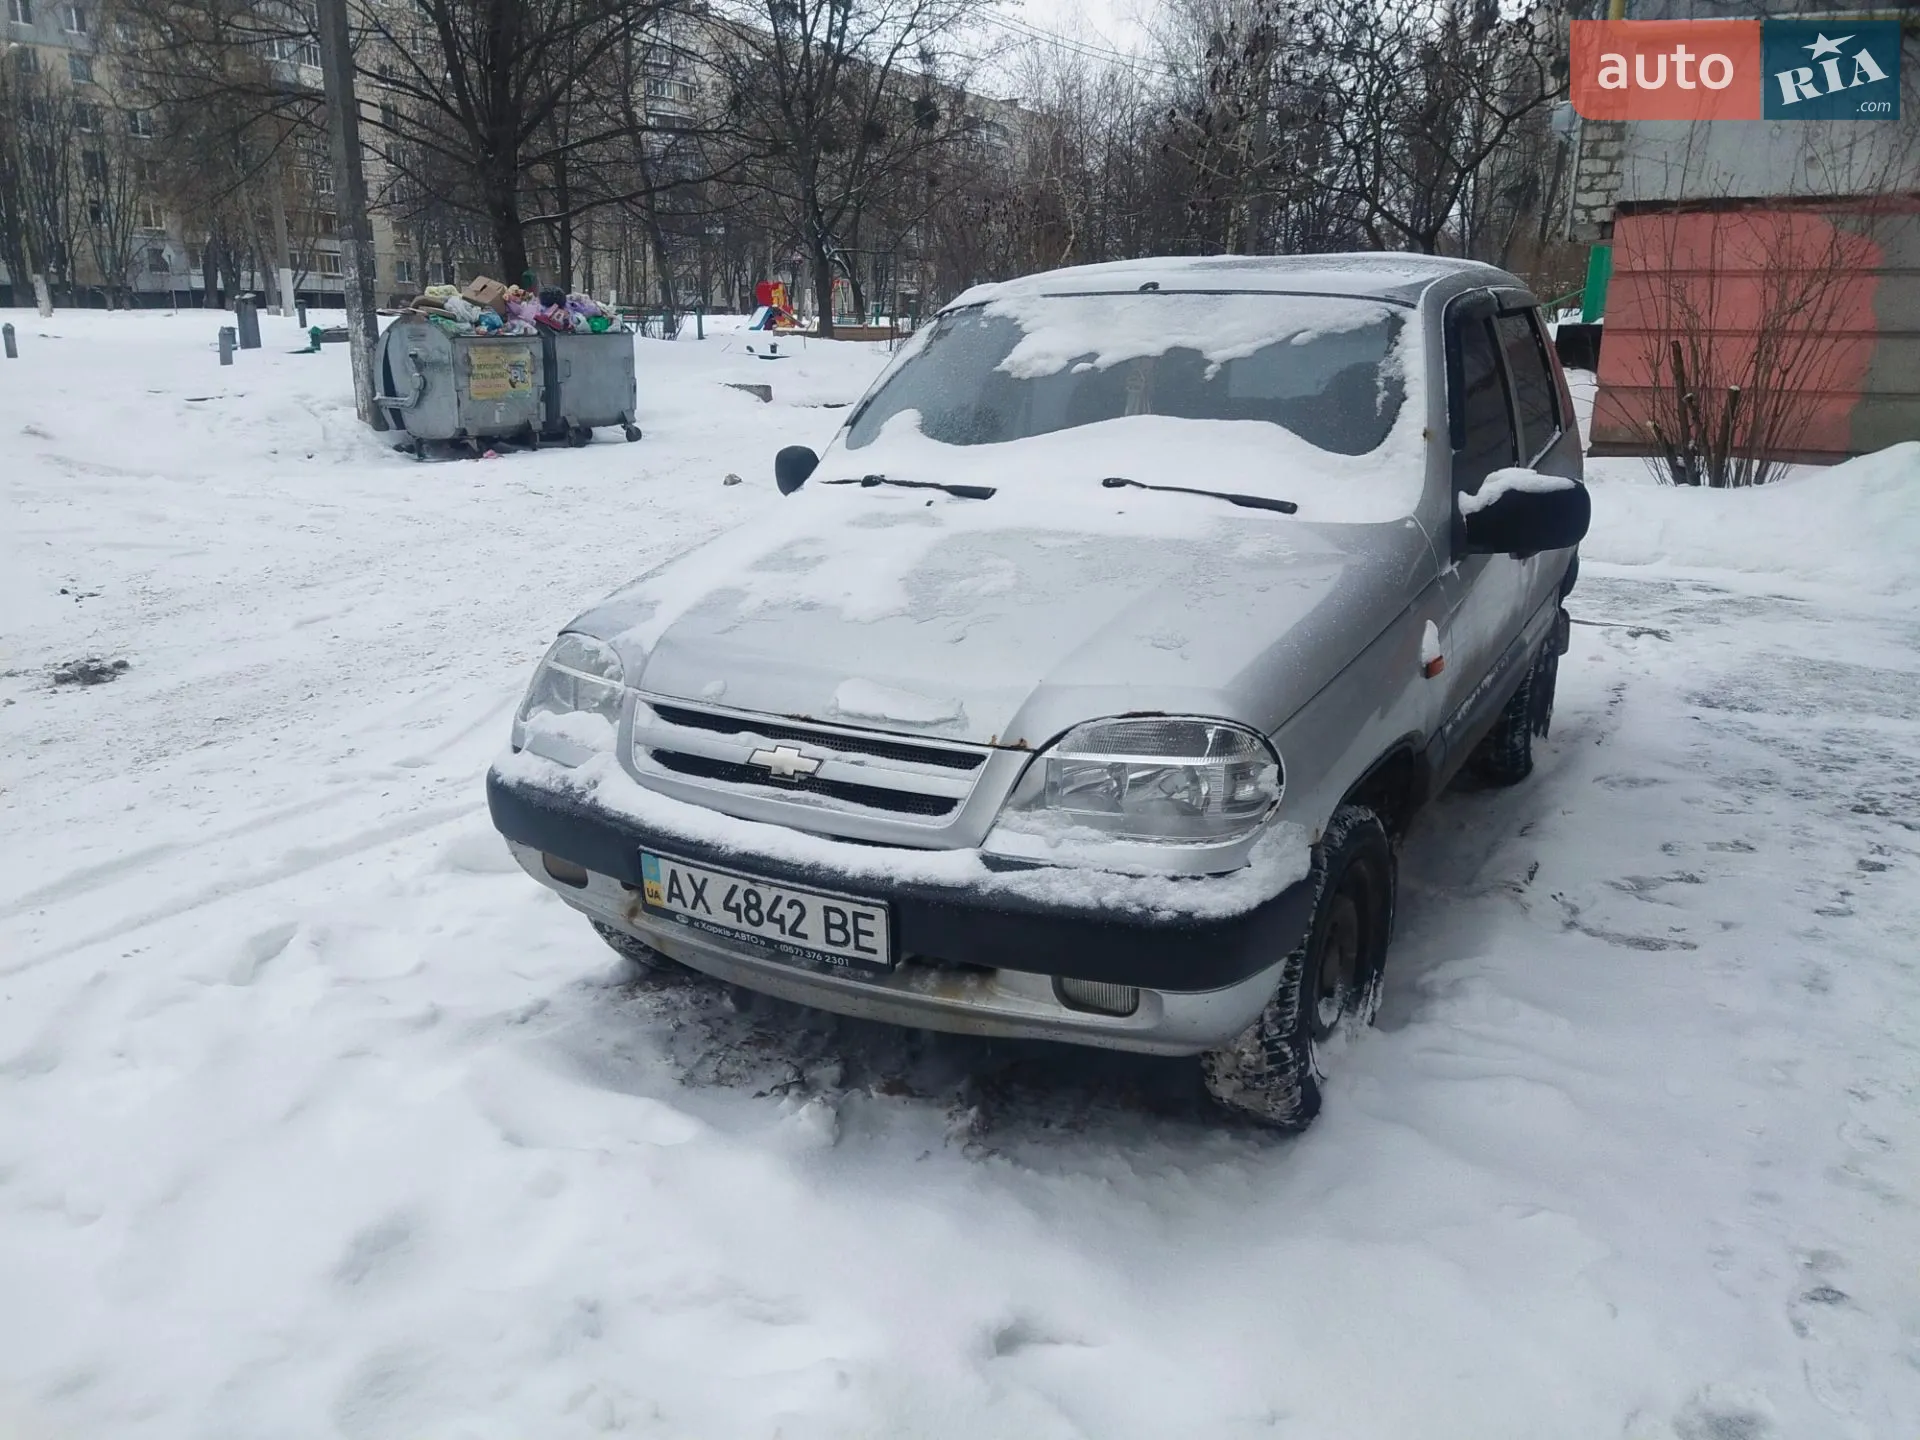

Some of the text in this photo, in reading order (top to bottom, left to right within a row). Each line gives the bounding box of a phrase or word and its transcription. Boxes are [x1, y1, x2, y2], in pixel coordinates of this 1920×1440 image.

[646, 886, 661, 900] UA
[666, 868, 878, 955] AX 4842 BE
[805, 949, 823, 961] 376
[824, 954, 849, 967] 2301
